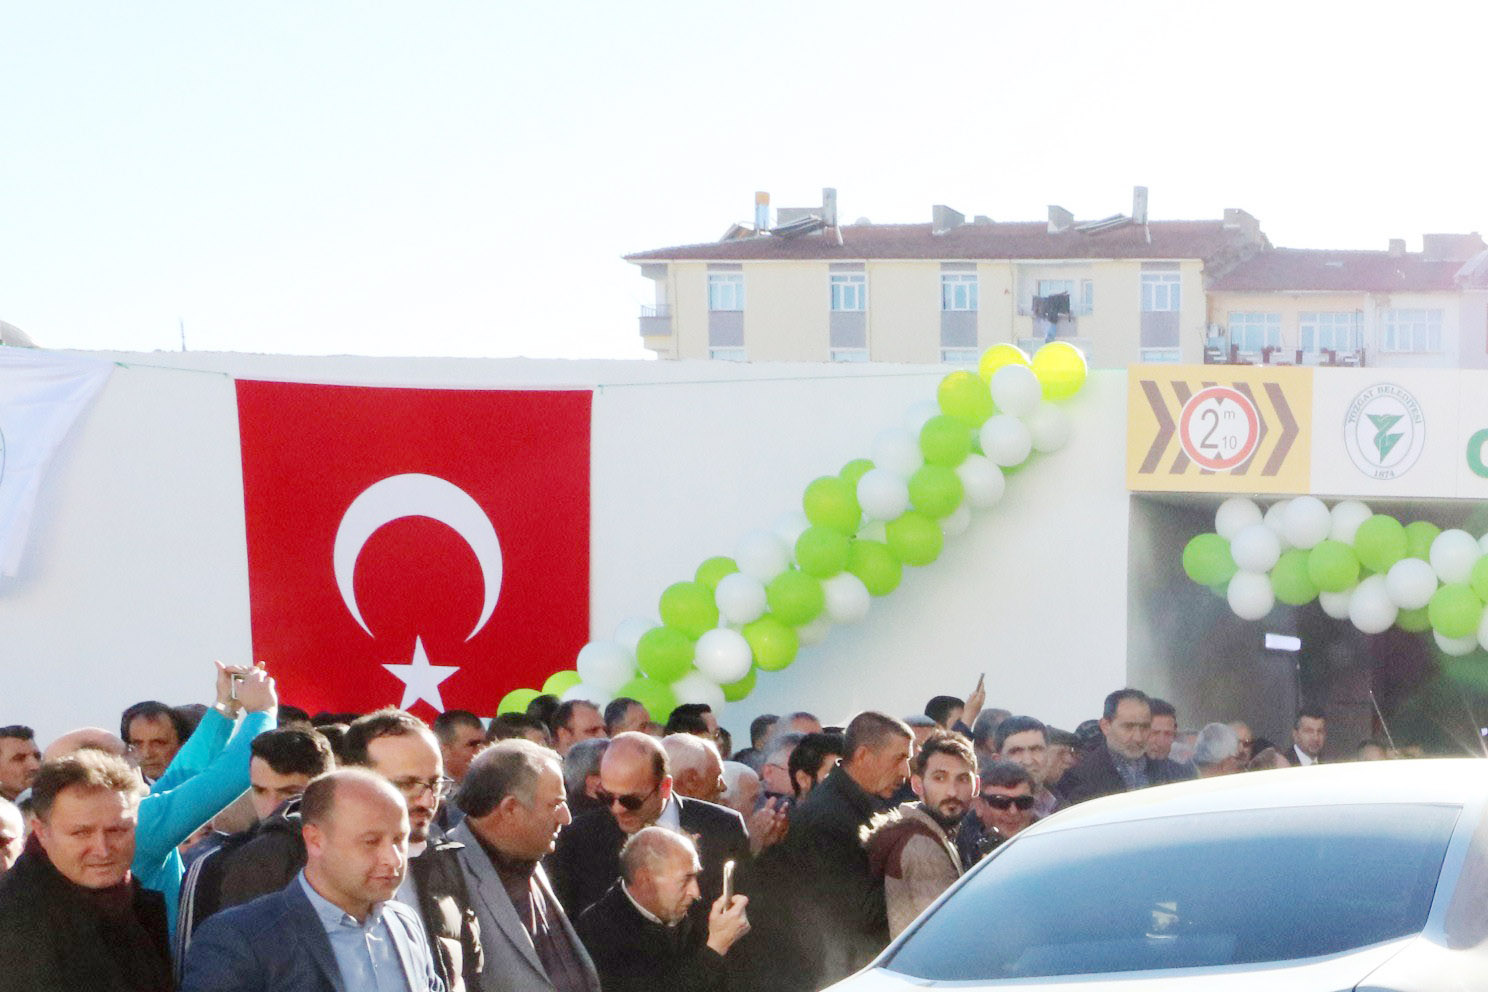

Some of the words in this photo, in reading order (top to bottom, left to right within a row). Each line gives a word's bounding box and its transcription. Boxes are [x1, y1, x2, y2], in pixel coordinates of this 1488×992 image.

[1223, 410, 1236, 420] m
[1347, 390, 1374, 424] YOZGAT
[1200, 408, 1219, 449] 2
[1222, 435, 1238, 450] 10
